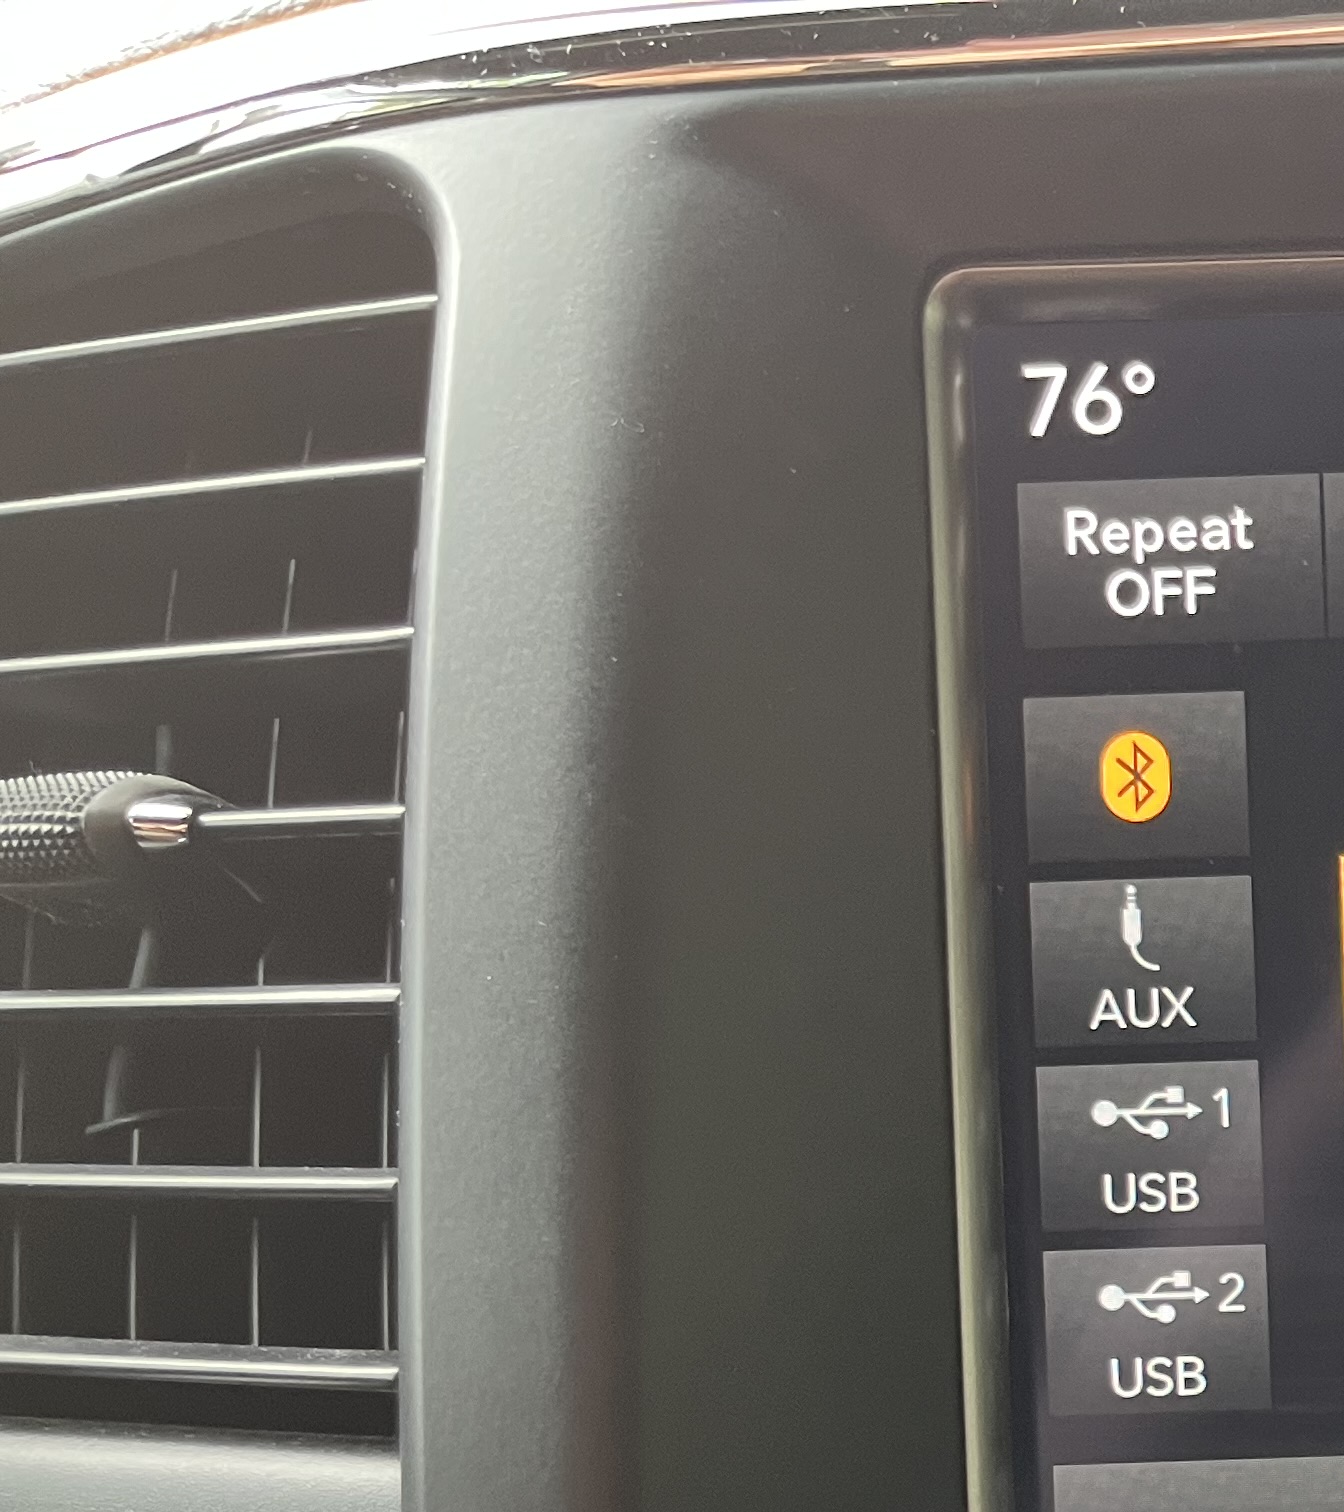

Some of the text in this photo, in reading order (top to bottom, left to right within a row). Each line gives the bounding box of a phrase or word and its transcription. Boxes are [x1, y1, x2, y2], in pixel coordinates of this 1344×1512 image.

[1020, 360, 1156, 438] 76°
[1063, 505, 1254, 564] Repeat
[1104, 565, 1217, 617] OFF
[1089, 986, 1197, 1030] AUX
[1212, 1087, 1230, 1128] 1
[1102, 1171, 1200, 1214] USB
[1218, 1272, 1246, 1313] 2
[1109, 1355, 1207, 1399] USB
